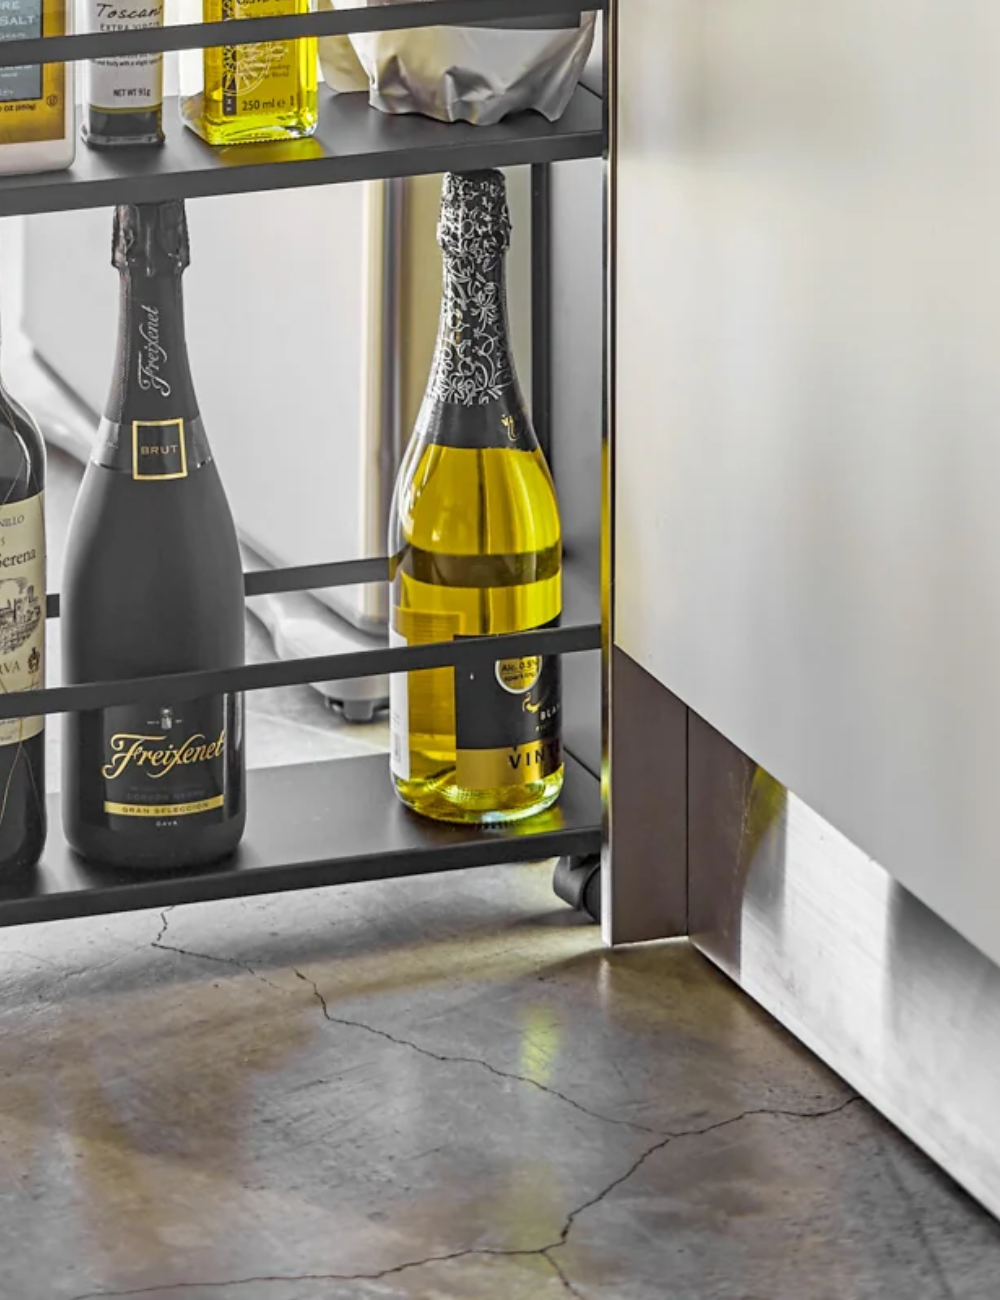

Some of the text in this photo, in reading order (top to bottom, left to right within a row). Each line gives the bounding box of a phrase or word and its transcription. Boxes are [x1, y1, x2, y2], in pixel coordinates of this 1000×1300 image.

[96, 2, 163, 19] Toscan
[112, 88, 126, 98] NET
[127, 88, 137, 97] WT
[242, 101, 260, 111] 250
[262, 99, 275, 109] ml
[138, 304, 171, 397] Freixenet
[140, 444, 179, 455] BRUT
[101, 727, 227, 779] Freixenet
[121, 806, 150, 814] GRAN
